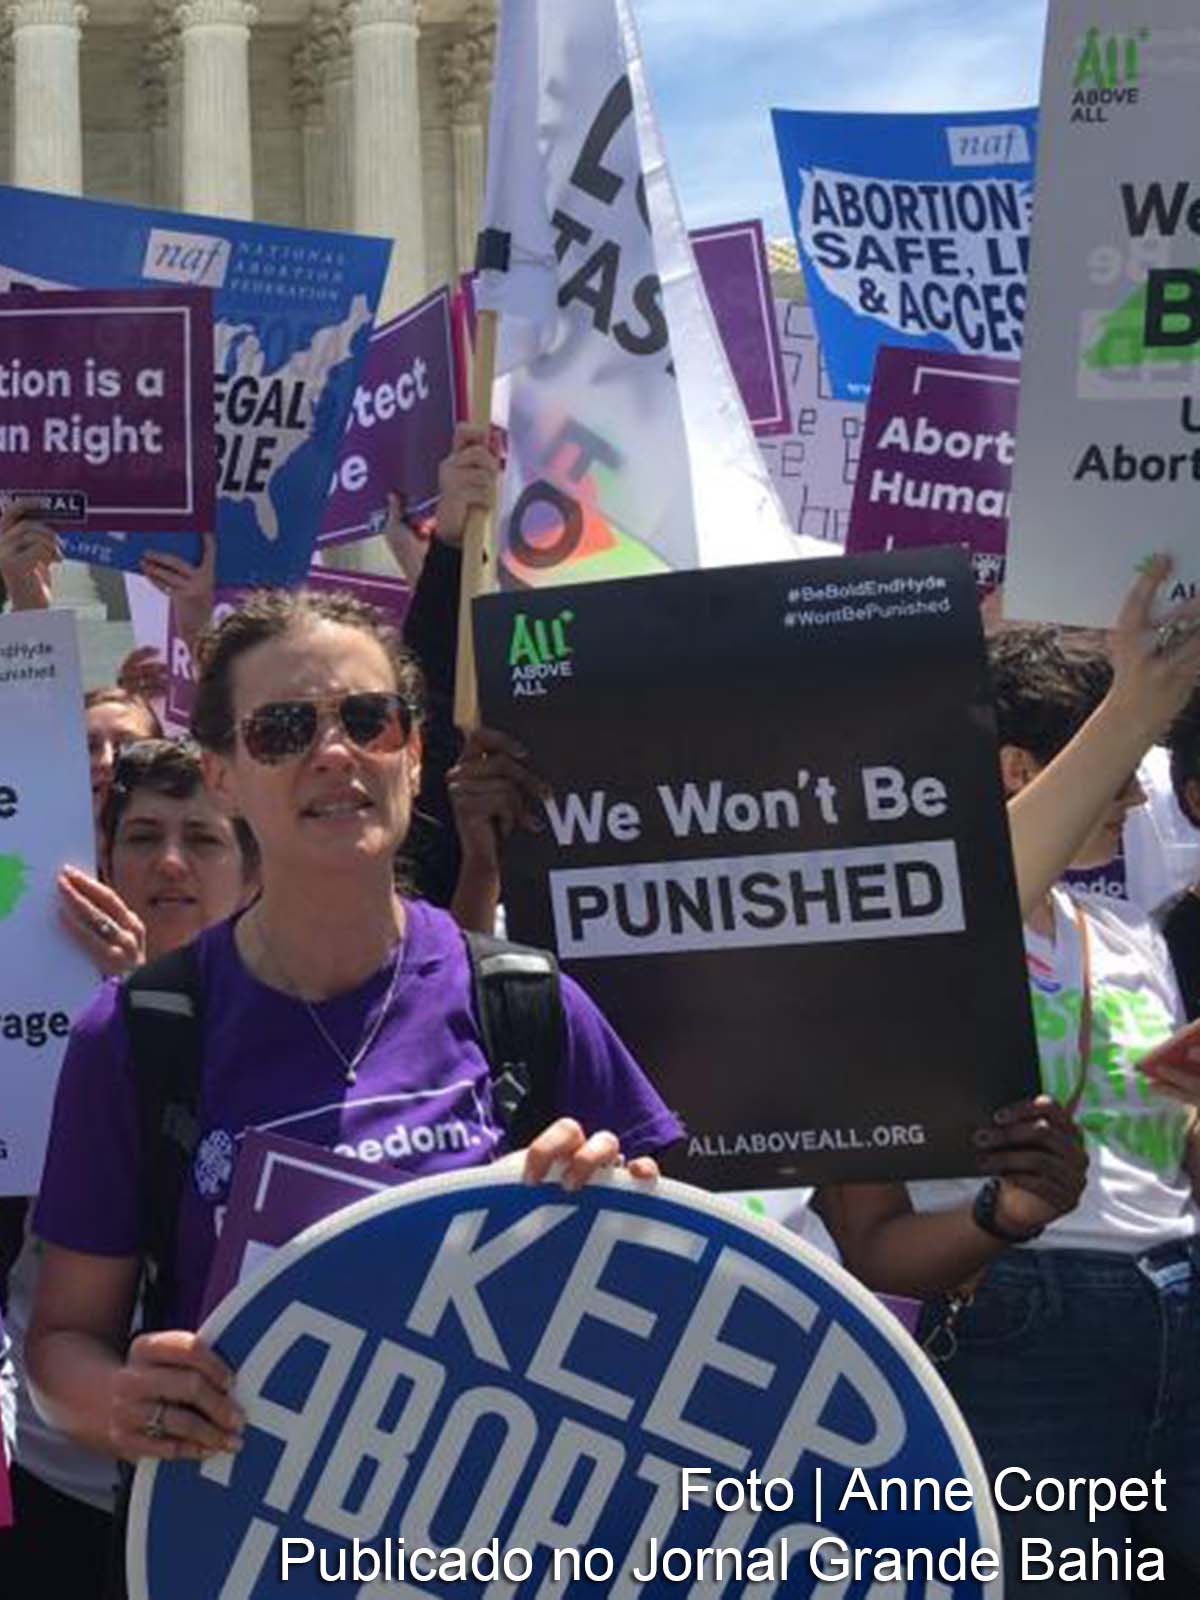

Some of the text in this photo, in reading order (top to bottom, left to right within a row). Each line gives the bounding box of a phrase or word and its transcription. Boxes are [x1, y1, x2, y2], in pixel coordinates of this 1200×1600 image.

[1071, 106, 1108, 123] ALL
[1072, 88, 1139, 106] ABOVE
[812, 232, 976, 280] SAFE,
[858, 277, 889, 314] &
[85, 360, 120, 397] is
[136, 369, 164, 398] a
[345, 357, 429, 430] tect
[44, 419, 163, 463] Right
[869, 468, 1013, 518] Huma
[512, 662, 573, 681] ABOVE
[513, 681, 547, 697] ALL
[542, 767, 949, 845] We Won't Be
[567, 860, 943, 942] PUNISHED
[688, 1125, 925, 1157] ALLABOVEALL.ORG
[407, 1204, 906, 1470] KEEP
